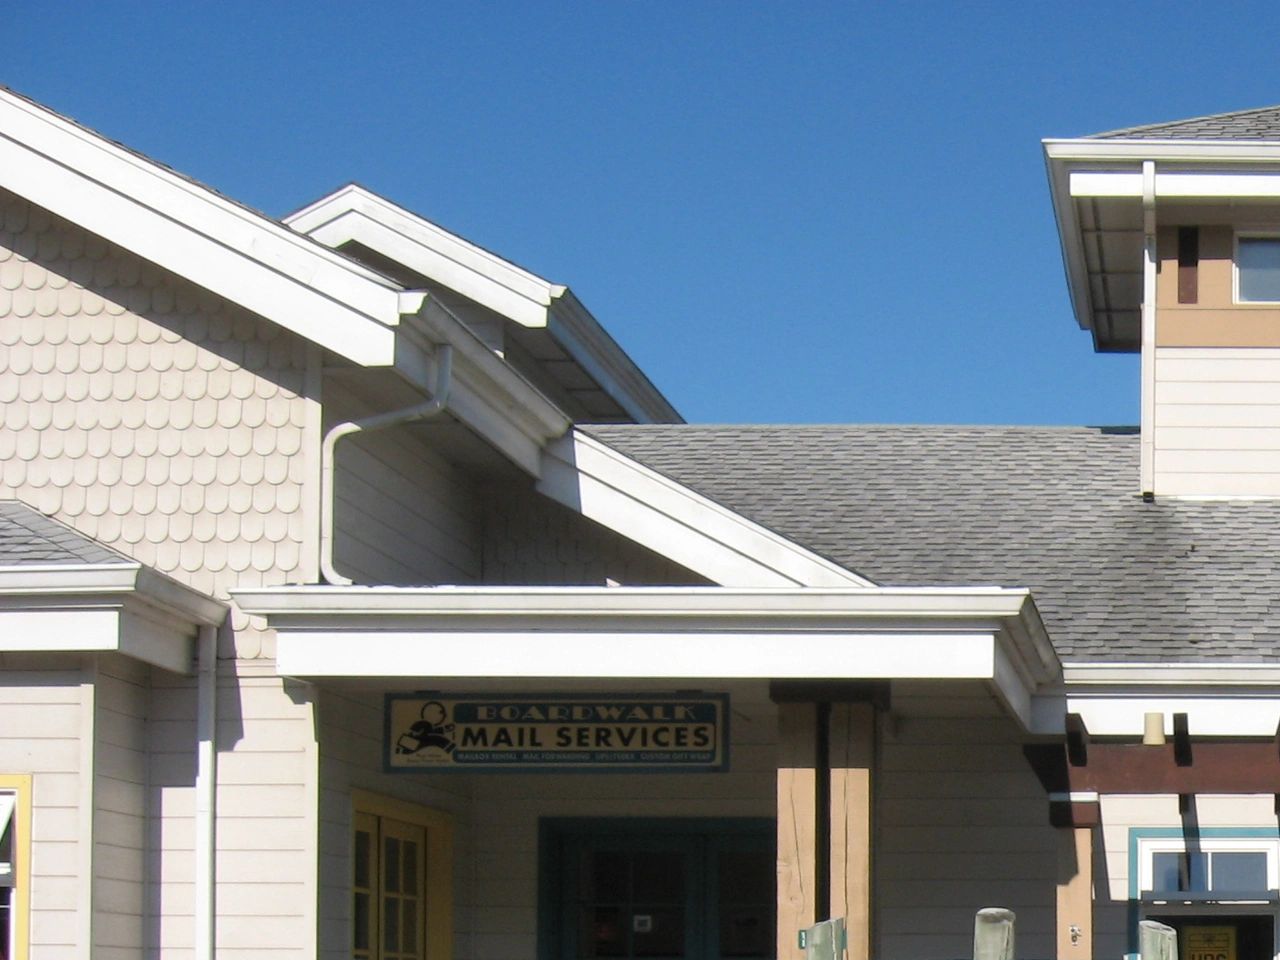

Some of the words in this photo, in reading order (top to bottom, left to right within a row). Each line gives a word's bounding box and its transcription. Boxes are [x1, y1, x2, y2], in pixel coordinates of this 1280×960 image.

[477, 705, 697, 721] BOARDWALK
[461, 727, 543, 748] MAIL
[556, 726, 710, 748] SERVICES
